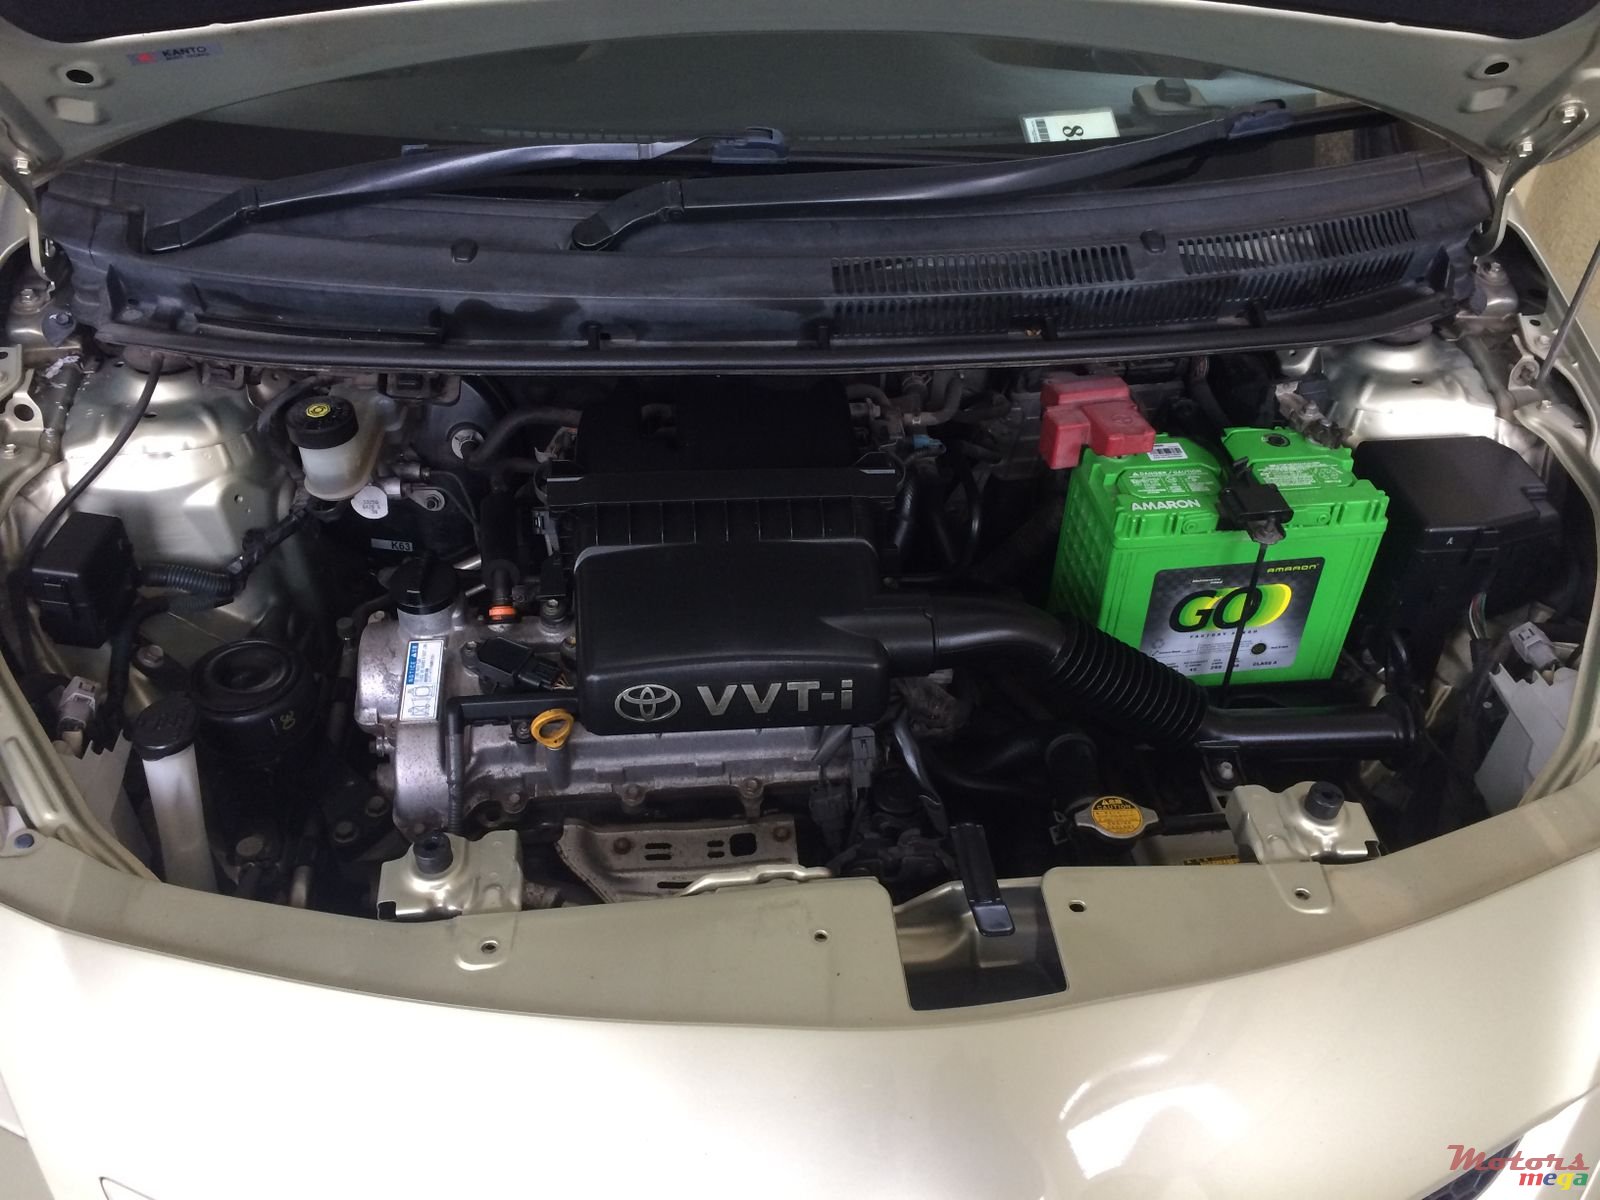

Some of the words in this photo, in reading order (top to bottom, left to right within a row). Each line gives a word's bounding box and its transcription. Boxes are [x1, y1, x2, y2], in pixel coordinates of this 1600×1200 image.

[161, 47, 207, 57] KANTO
[1131, 499, 1201, 512] AMARON
[391, 541, 411, 551] K63
[1266, 564, 1318, 574] AMARON
[1169, 587, 1263, 632] GO
[408, 660, 417, 683] NOTICE
[696, 679, 853, 716] VVT-i
